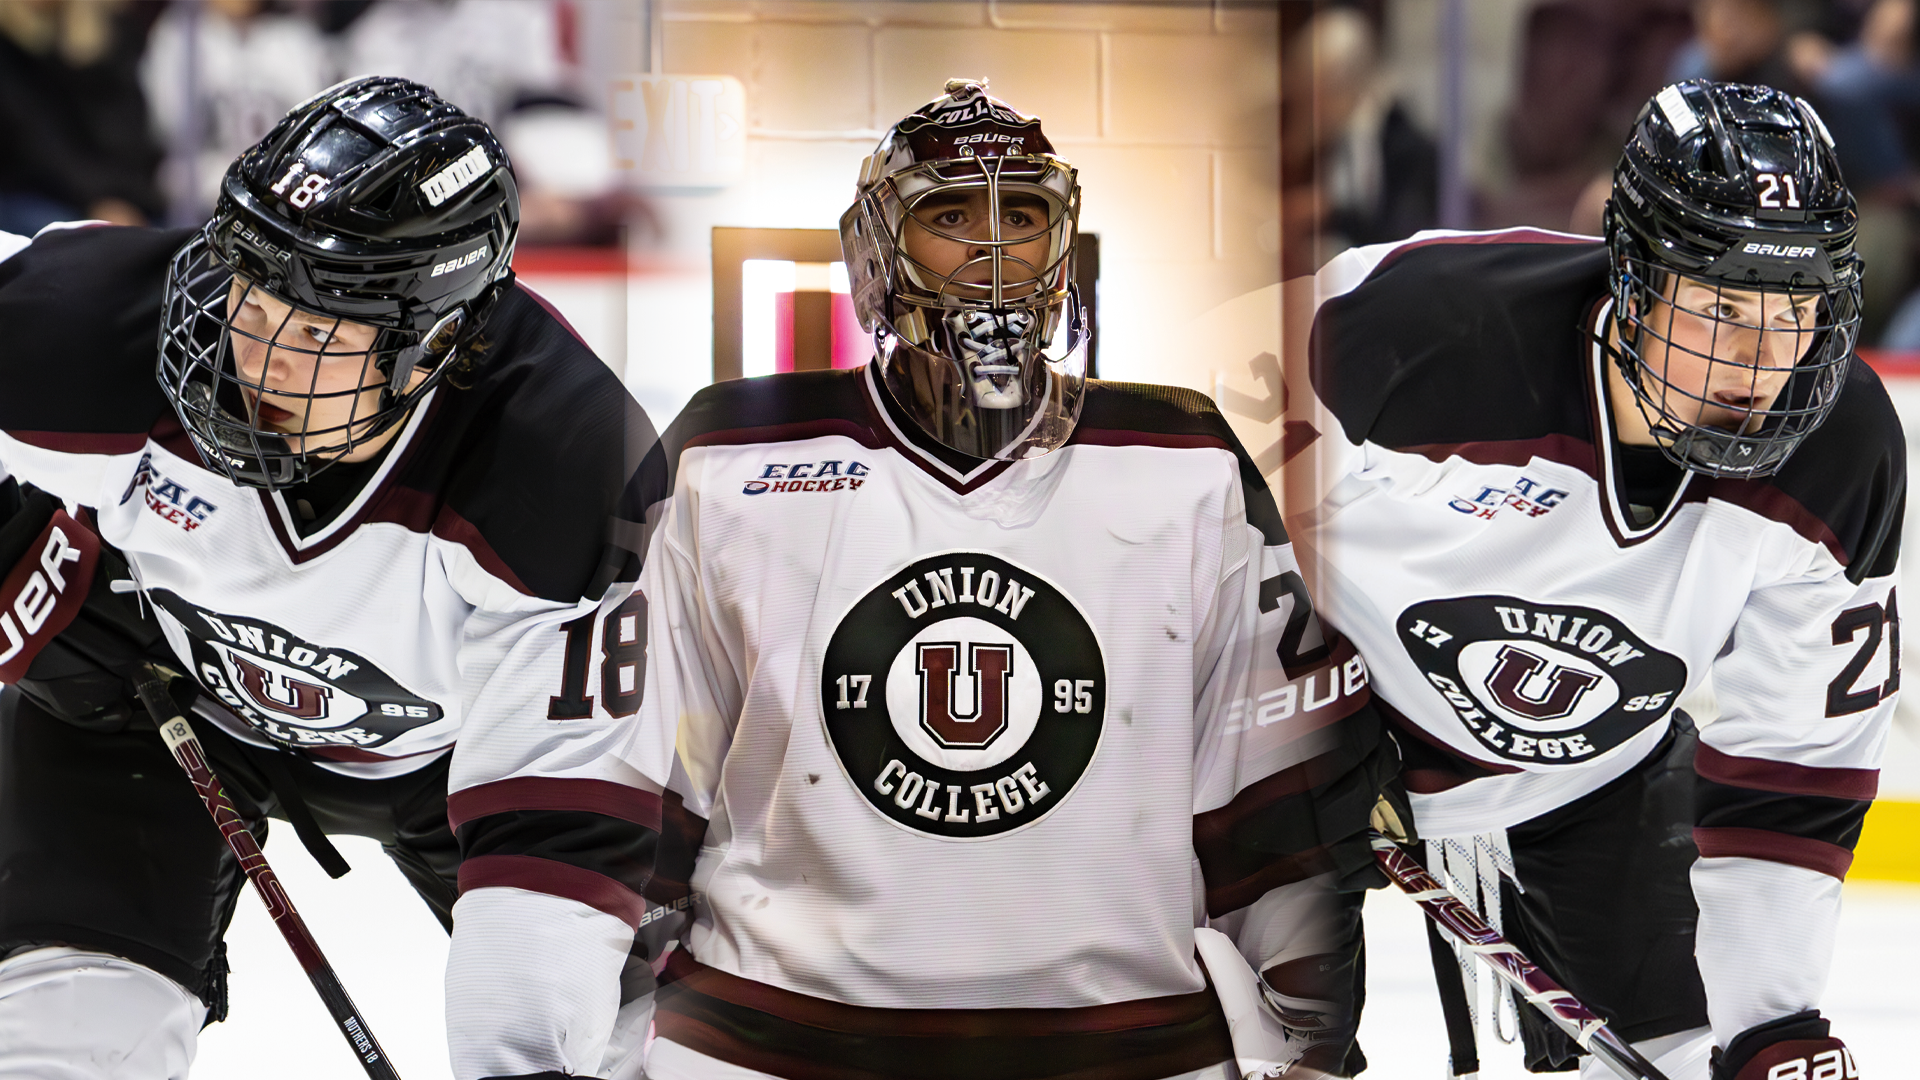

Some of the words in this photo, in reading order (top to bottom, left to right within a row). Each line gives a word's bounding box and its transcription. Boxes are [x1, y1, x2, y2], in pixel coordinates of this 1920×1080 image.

[607, 80, 724, 172] EXIT
[271, 163, 331, 209] 18
[420, 145, 492, 207] UNION
[1756, 173, 1801, 208] 21
[757, 460, 871, 479] ECAC
[770, 477, 866, 493] HOCKEY
[892, 567, 1036, 621] UNION
[197, 611, 359, 680] UNION
[547, 589, 649, 720] 18
[1494, 606, 1645, 667] UNION
[1824, 585, 1902, 718] 21
[226, 648, 333, 719] U
[380, 703, 429, 718] 95
[836, 674, 872, 710] 17
[915, 641, 1014, 750] U
[1054, 679, 1094, 714] 95
[1409, 619, 1453, 648] 17
[1484, 643, 1603, 721] U
[1623, 690, 1673, 712] 95
[166, 722, 187, 741] 18
[1427, 671, 1596, 759] COLLEGE
[874, 759, 1051, 823] COLLEGE
[343, 1015, 372, 1053] MUTHERS
[364, 1050, 379, 1064] 18
